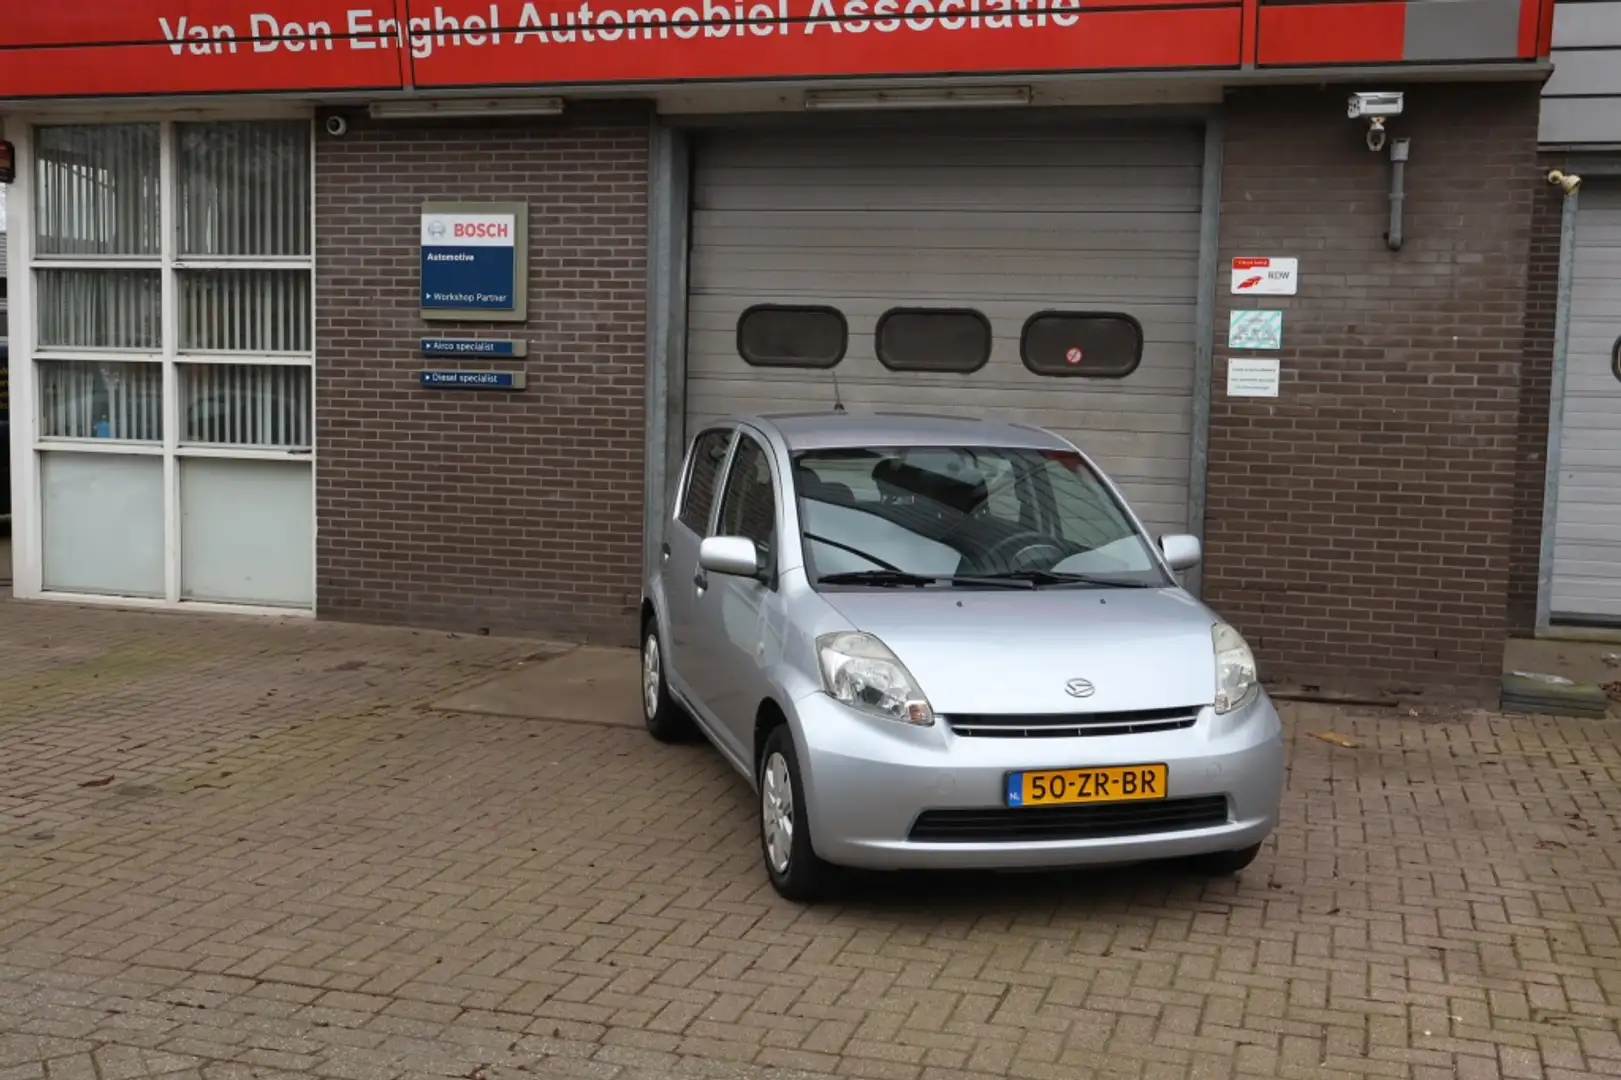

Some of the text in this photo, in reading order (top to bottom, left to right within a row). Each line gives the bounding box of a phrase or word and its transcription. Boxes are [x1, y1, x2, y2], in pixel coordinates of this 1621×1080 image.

[158, 0, 1081, 59] Van Den Enghel Automobiel Associatie
[454, 223, 508, 238] BOSCH
[427, 252, 475, 262] Automotive
[433, 292, 507, 303] Workshop Partner
[433, 341, 494, 352] Airco specialist
[432, 372, 498, 384] Diesel specialist
[1009, 769, 1156, 801] NL 50-ZR-BR
